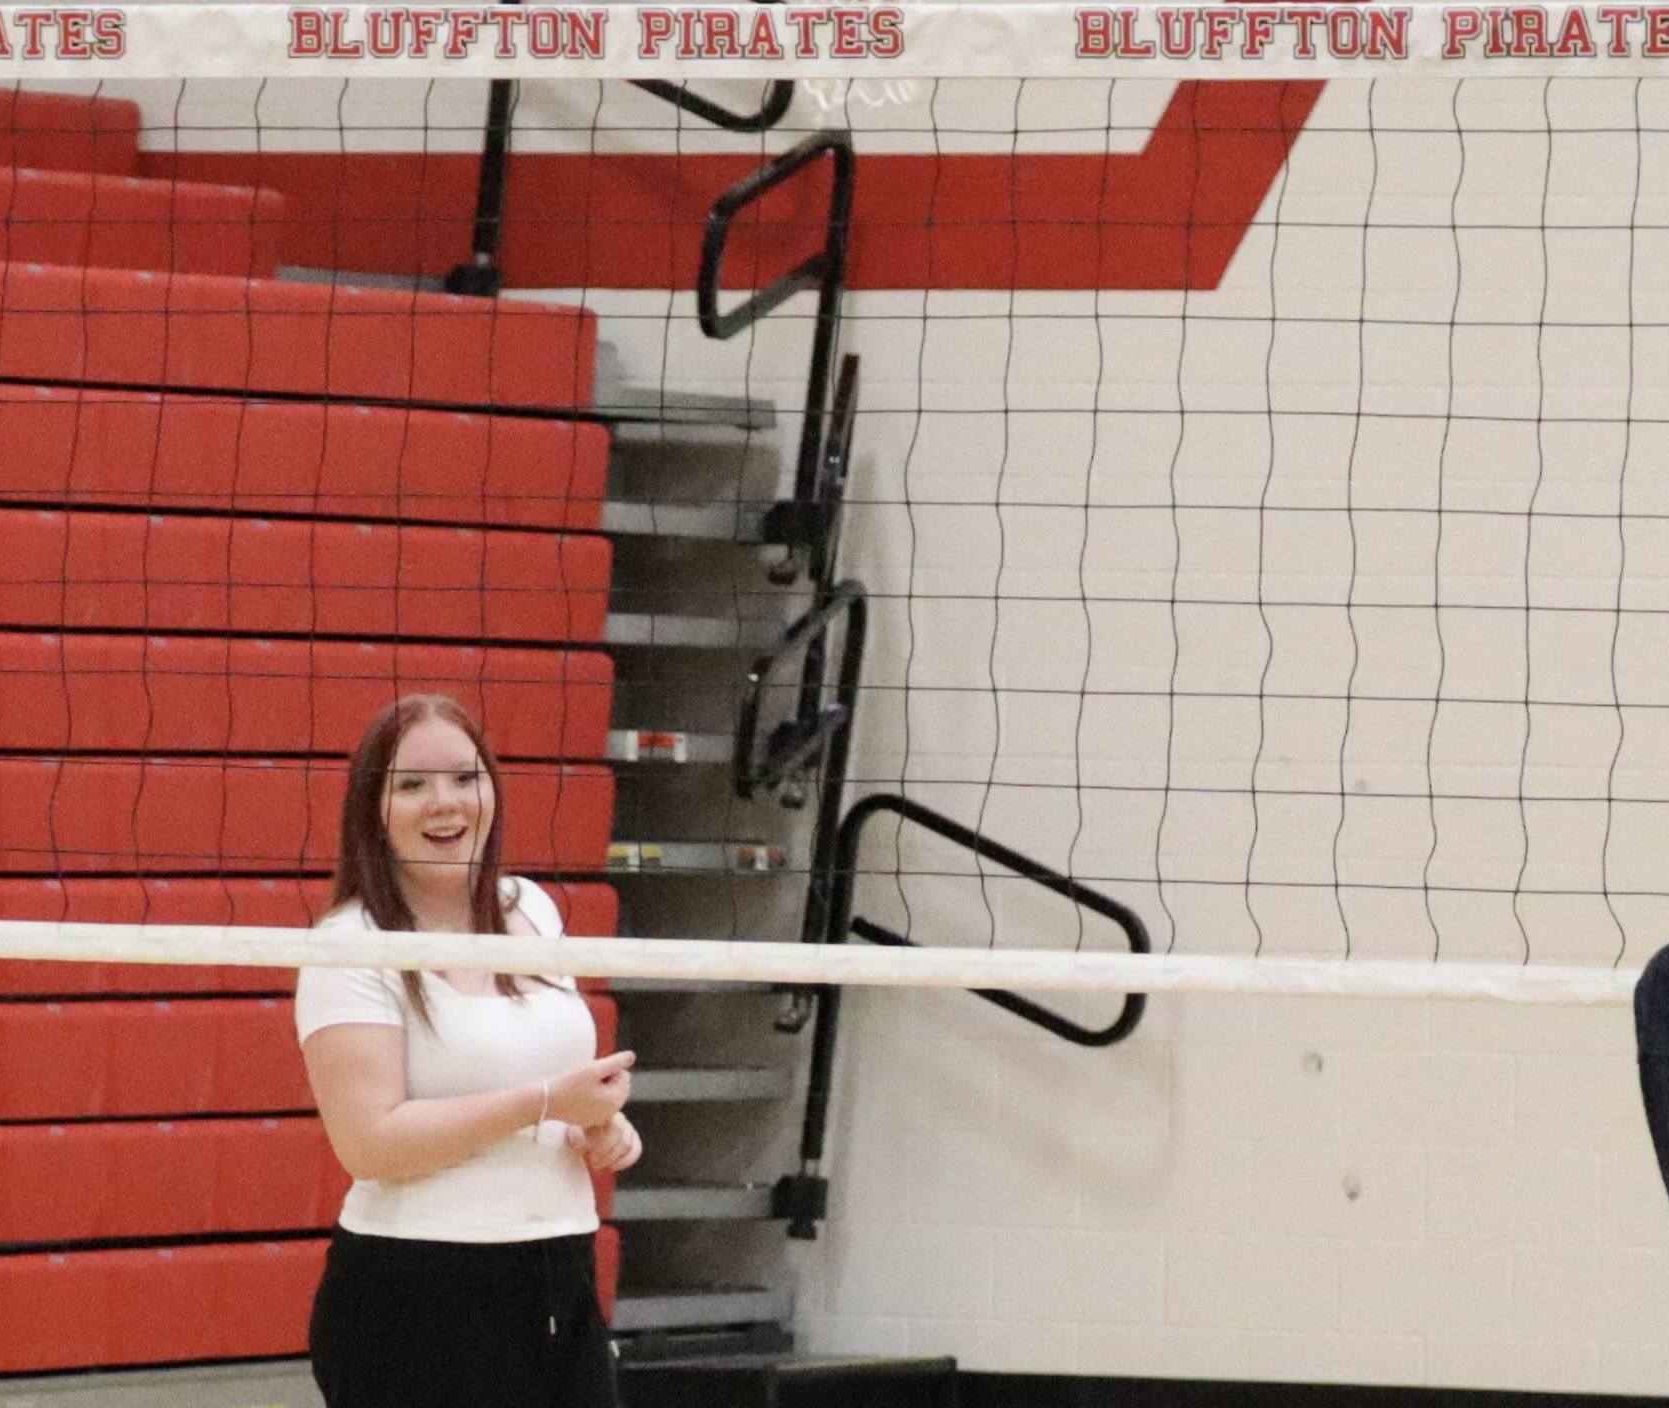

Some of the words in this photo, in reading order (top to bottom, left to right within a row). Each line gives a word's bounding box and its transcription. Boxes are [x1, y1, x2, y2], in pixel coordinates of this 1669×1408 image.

[287, 7, 609, 58] BLUFFTON
[638, 8, 905, 58] PIRATES
[1074, 6, 1413, 59] BLUFFTON
